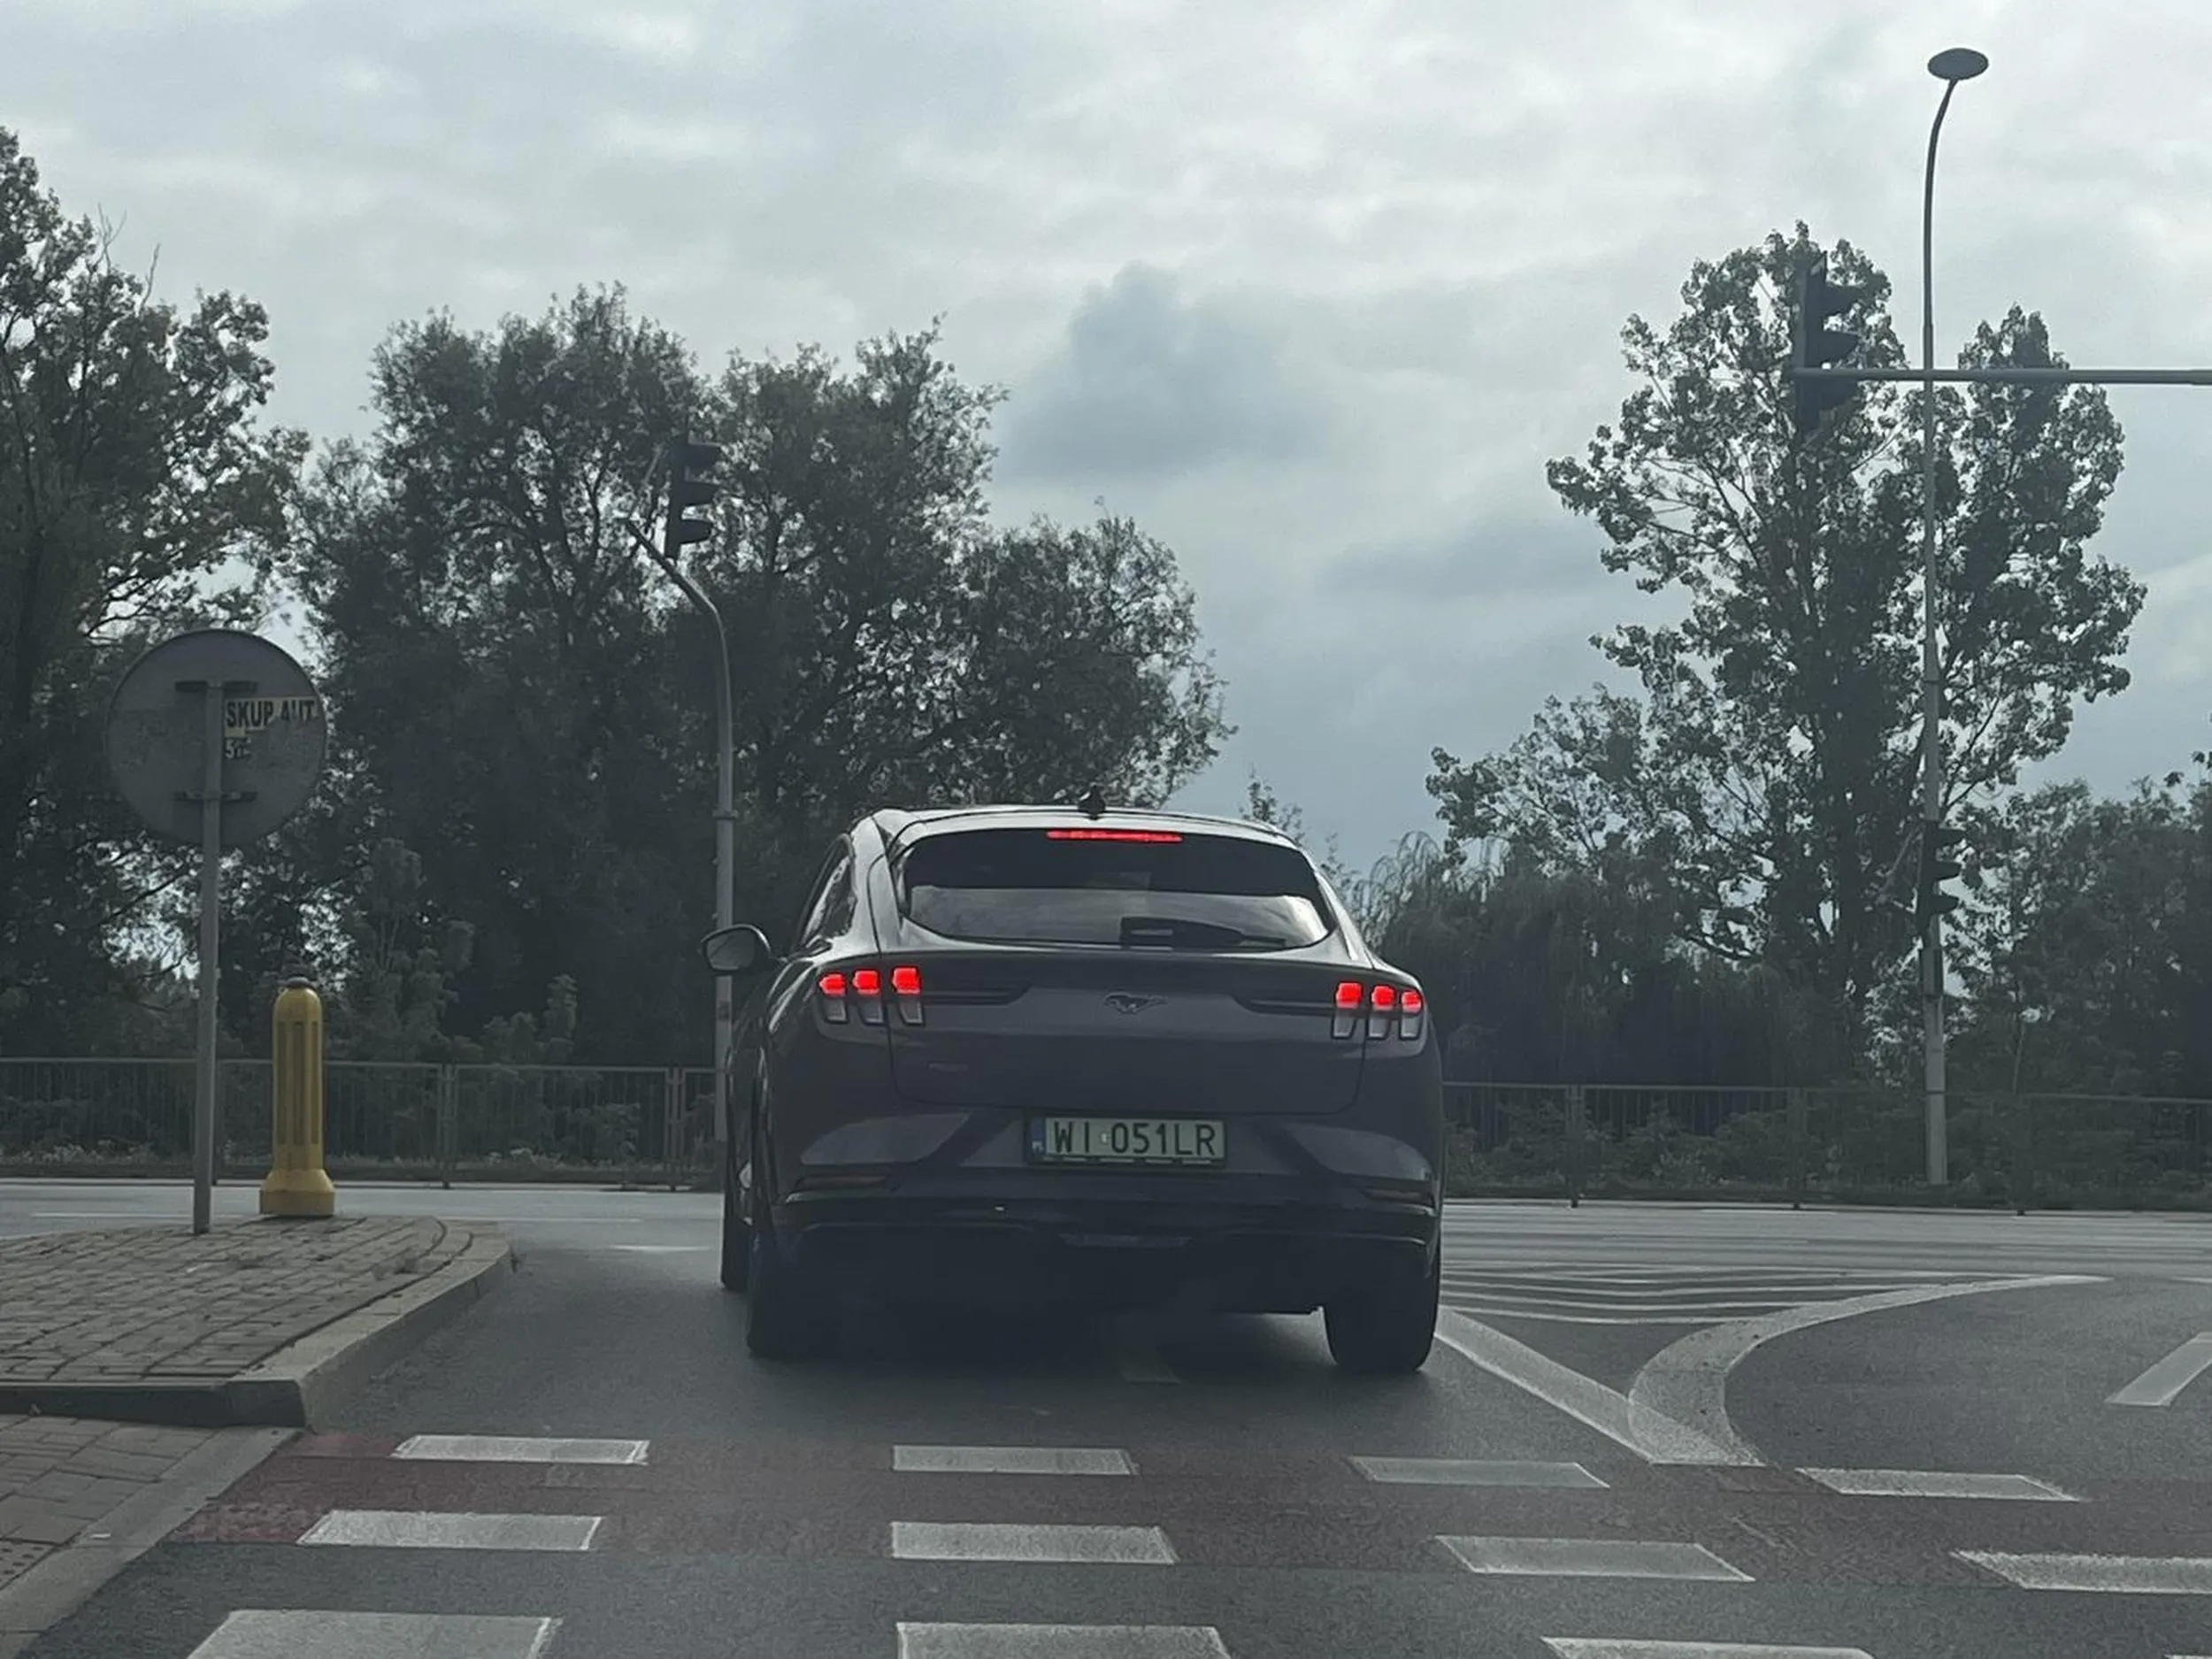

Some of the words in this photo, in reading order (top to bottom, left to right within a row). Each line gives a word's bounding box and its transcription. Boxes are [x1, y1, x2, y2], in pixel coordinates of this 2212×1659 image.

[227, 700, 274, 727] SKUP
[1054, 1121, 1090, 1153] WI
[1110, 1122, 1217, 1156] 051LR
